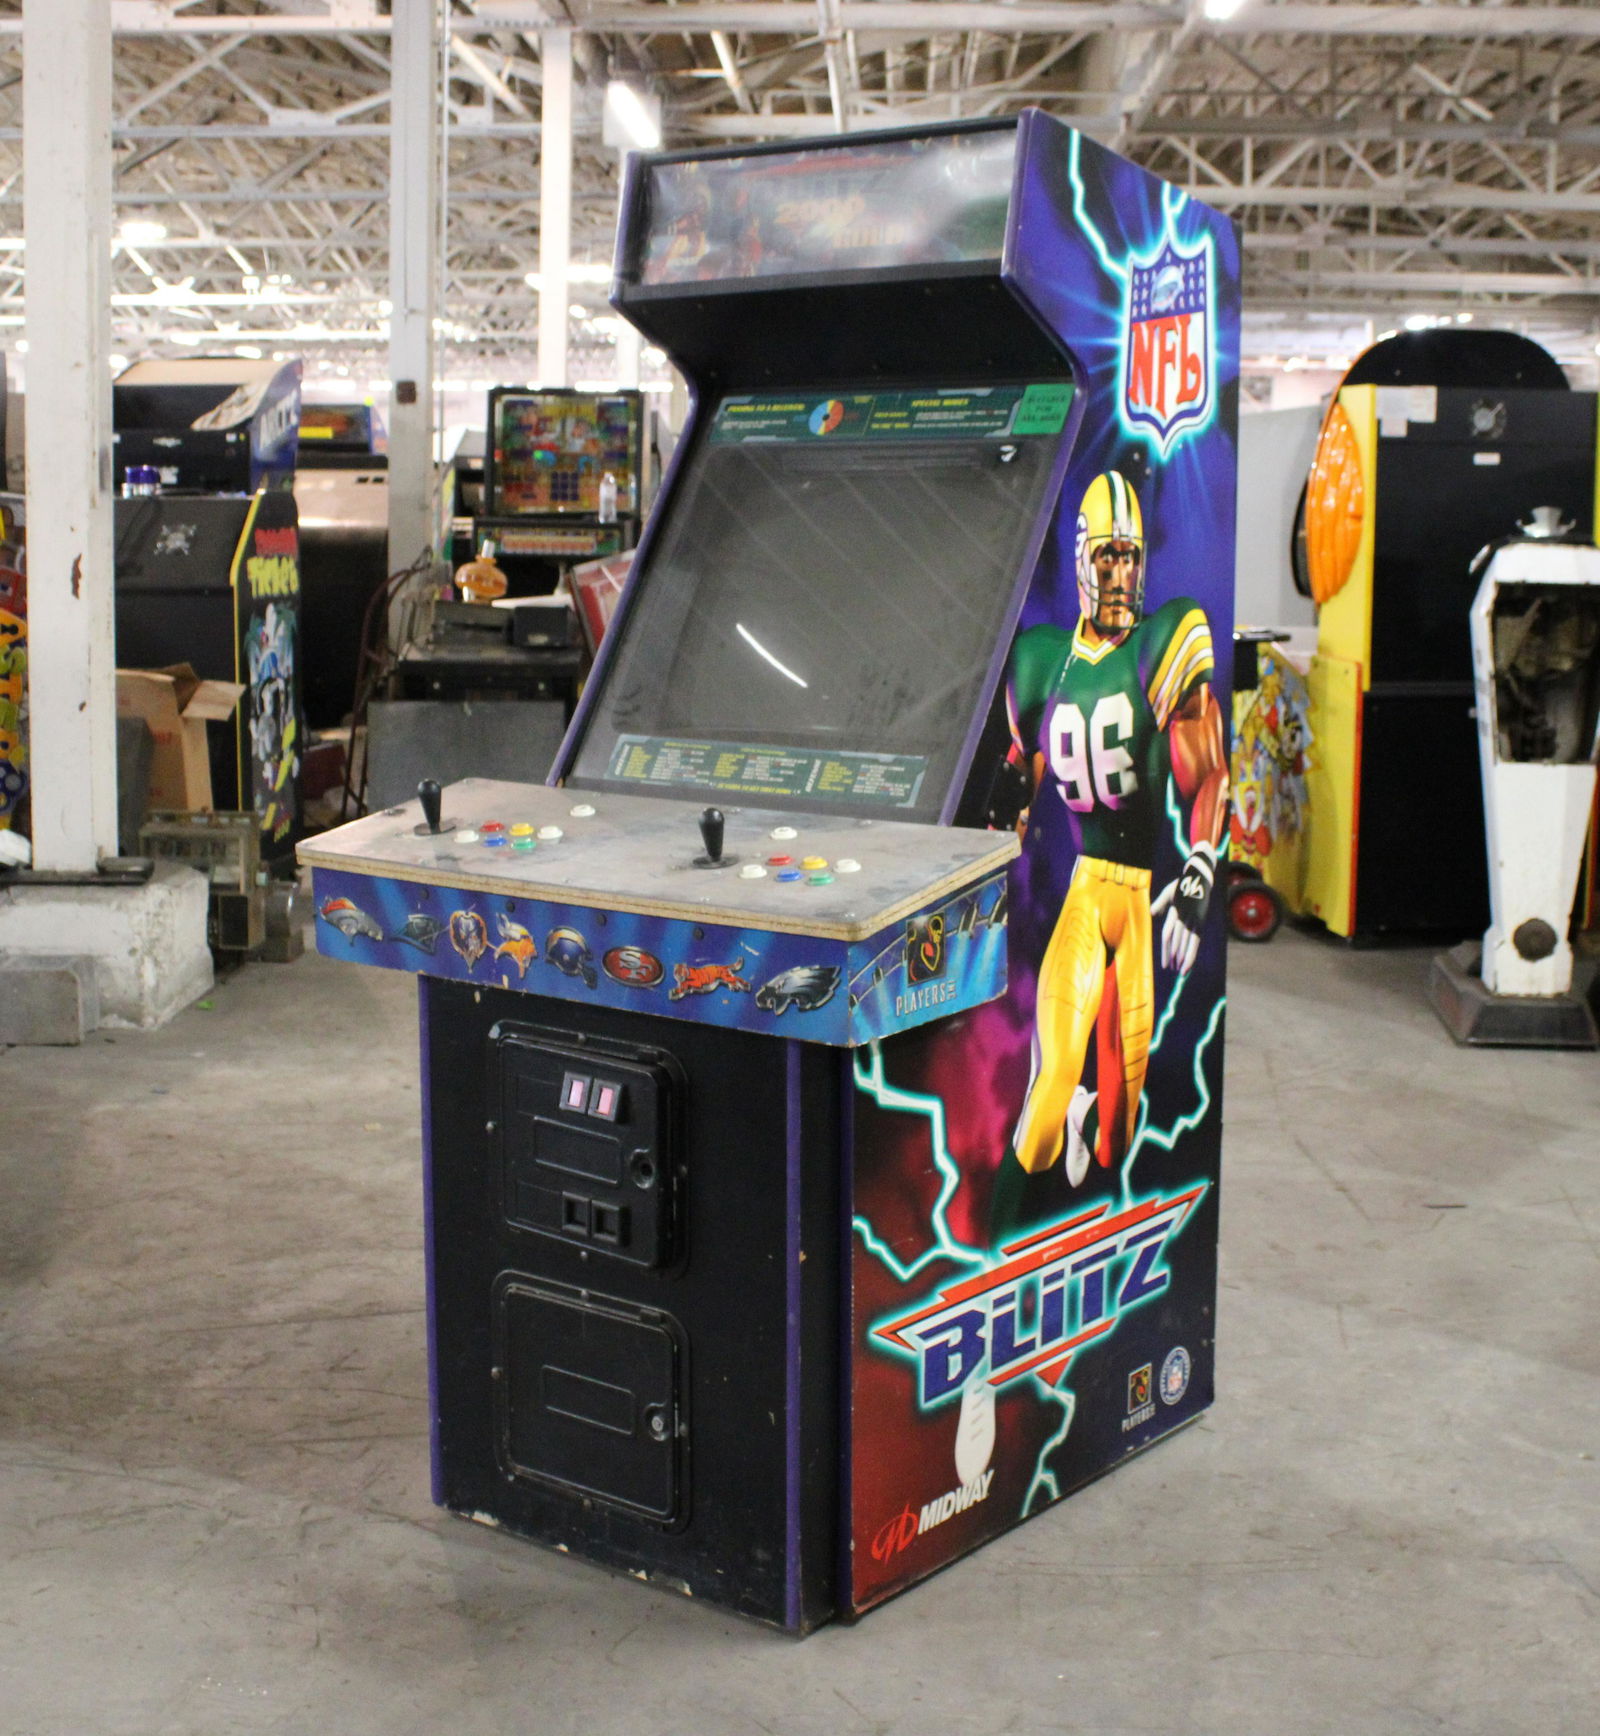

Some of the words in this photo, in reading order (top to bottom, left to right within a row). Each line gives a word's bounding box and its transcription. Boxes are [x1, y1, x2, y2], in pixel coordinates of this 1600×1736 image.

[1129, 314, 1202, 417] NFL
[1049, 691, 1138, 812] 96
[896, 983, 947, 1017] PLAYERS
[919, 1215, 1174, 1405] BLITZ
[917, 1469, 995, 1535] MIDWAY
